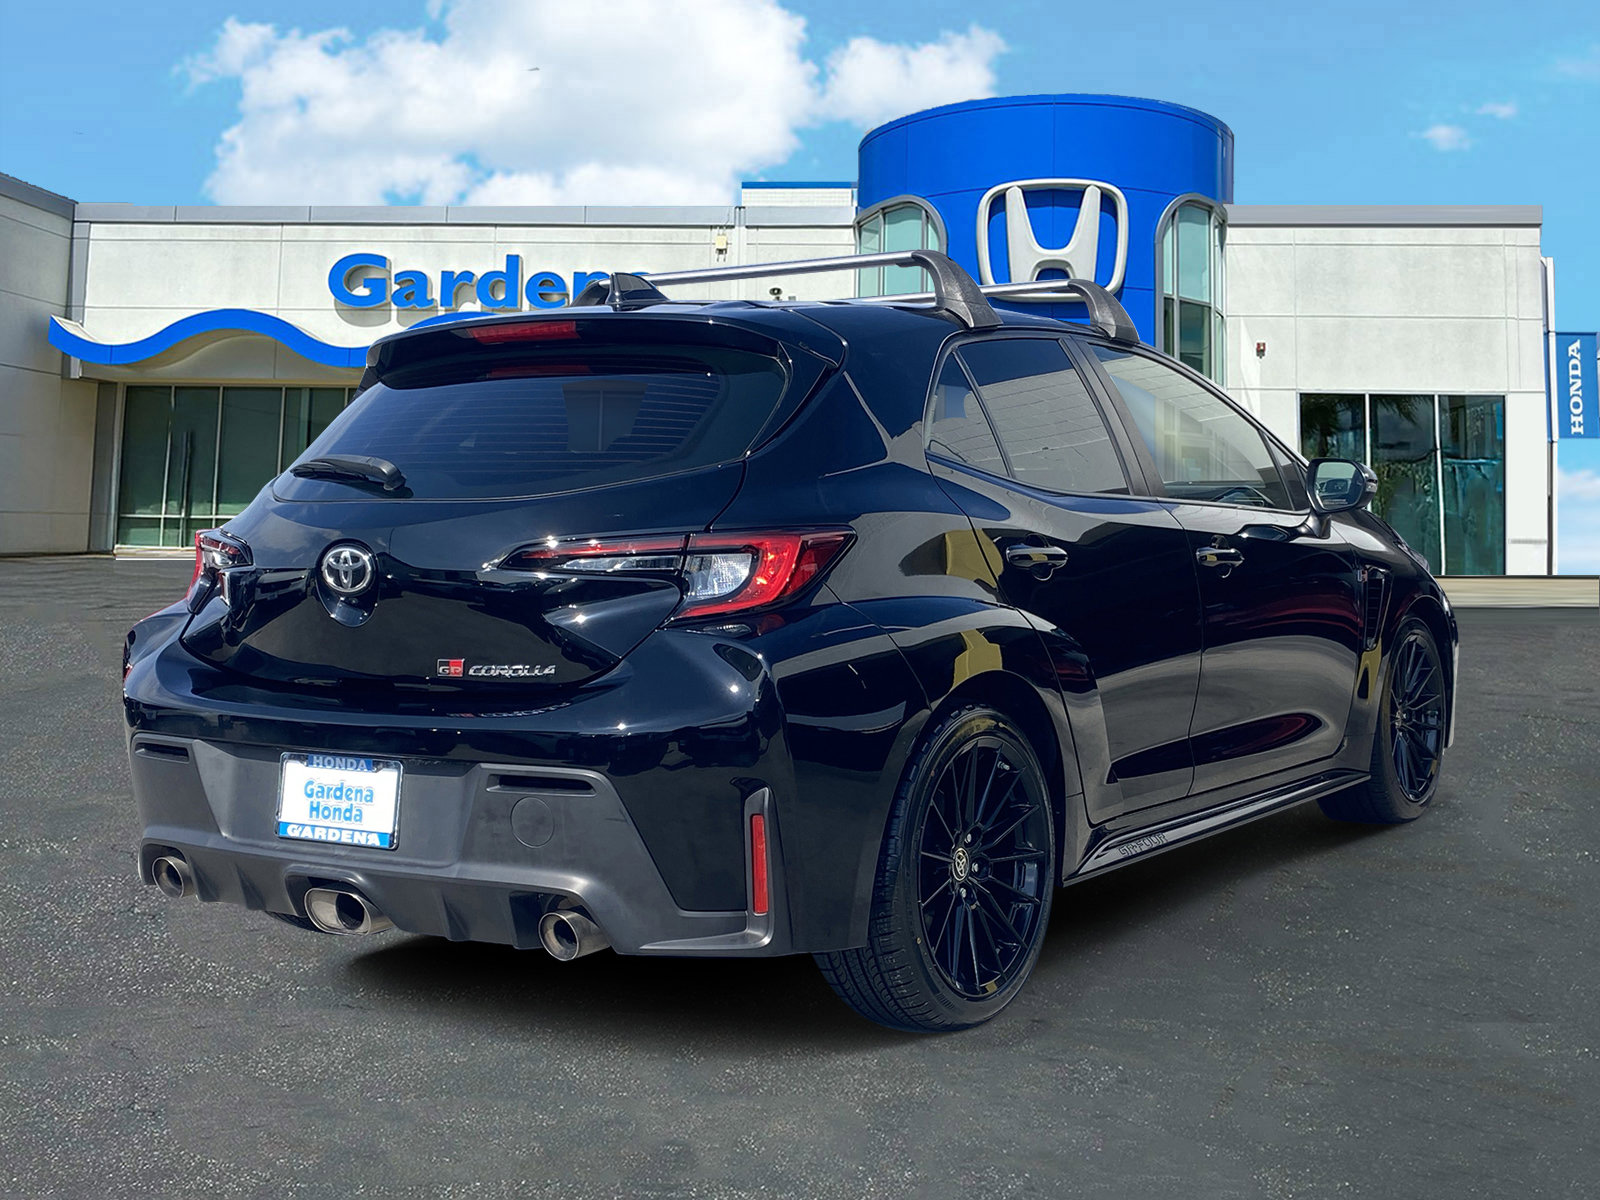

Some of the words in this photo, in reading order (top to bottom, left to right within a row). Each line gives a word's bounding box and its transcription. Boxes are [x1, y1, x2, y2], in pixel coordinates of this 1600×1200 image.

[328, 253, 651, 308] Garden
[1568, 339, 1584, 435] HONDA
[468, 665, 556, 678] COROLLA
[313, 756, 369, 772] HONDA
[304, 780, 374, 803] Gardena
[309, 801, 363, 823] Honda
[286, 824, 381, 847] GARDENA
